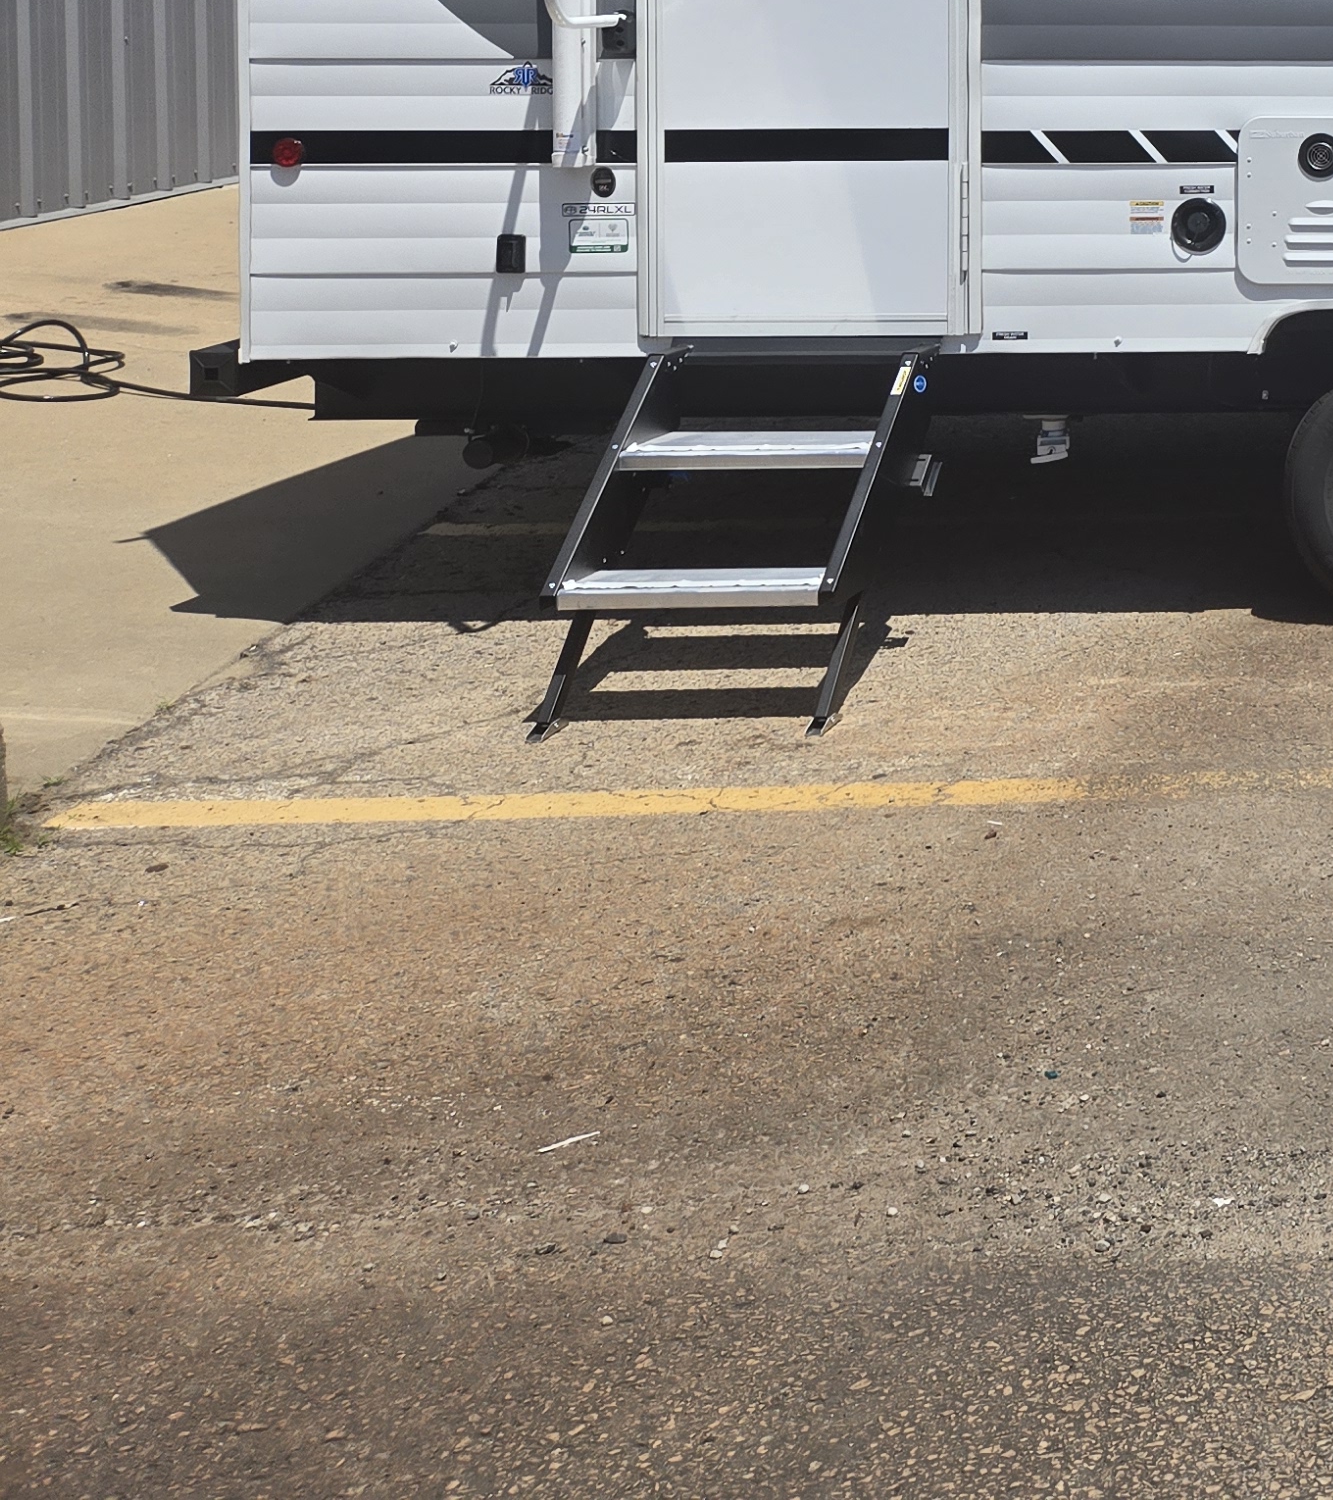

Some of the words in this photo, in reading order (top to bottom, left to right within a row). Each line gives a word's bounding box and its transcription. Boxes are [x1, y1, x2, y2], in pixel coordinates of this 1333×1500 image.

[489, 85, 521, 95] ROCKY
[531, 85, 553, 95] RIDG
[579, 205, 632, 214] 24RLXL
